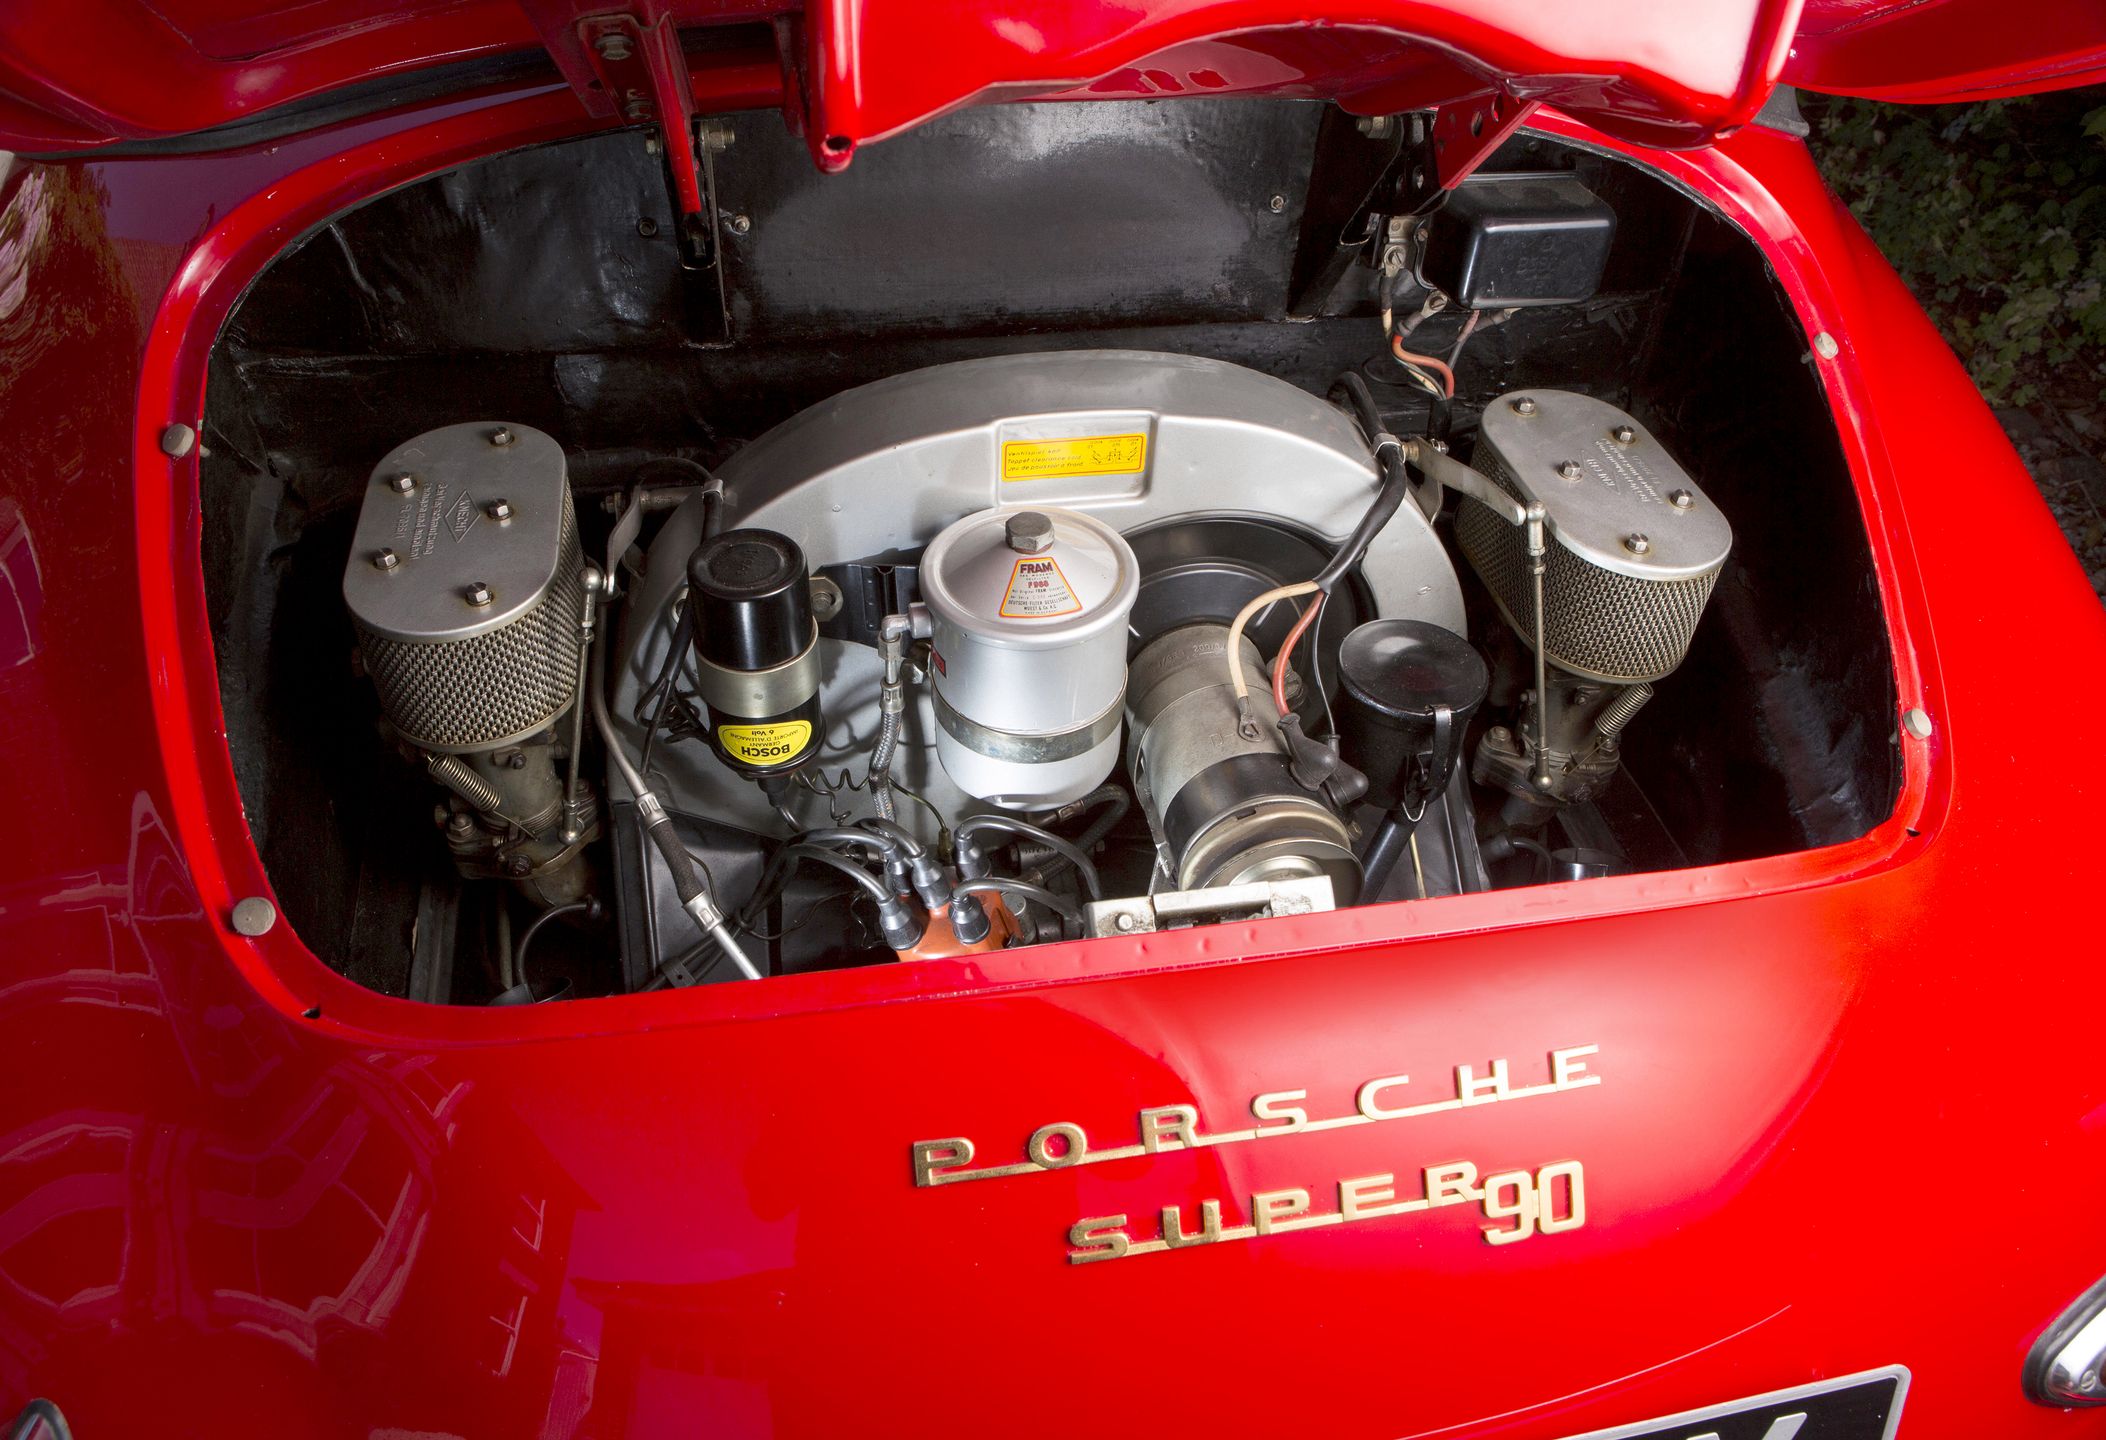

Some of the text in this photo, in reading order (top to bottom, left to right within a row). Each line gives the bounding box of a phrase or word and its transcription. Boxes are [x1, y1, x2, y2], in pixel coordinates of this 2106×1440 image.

[455, 499, 471, 532] KNECHT
[1020, 562, 1053, 573] FRAM
[741, 744, 790, 757] BOSCH
[913, 1044, 1600, 1187] PORSCHE
[1069, 1159, 1586, 1265] SUPER 90
